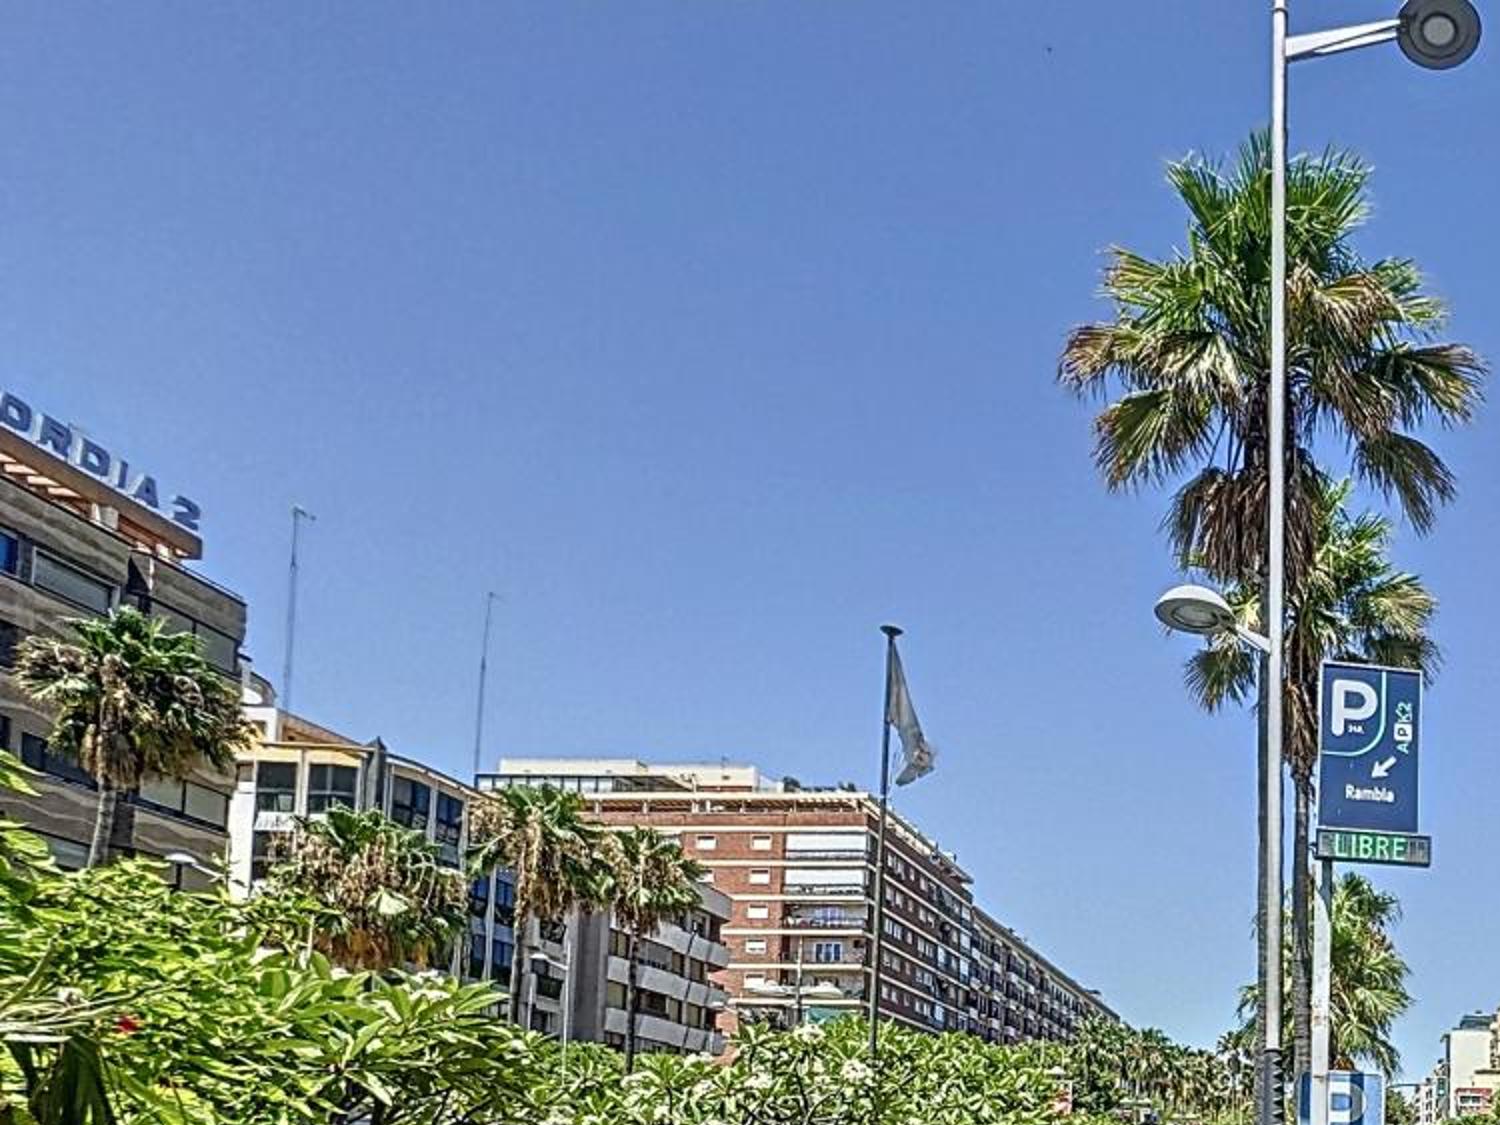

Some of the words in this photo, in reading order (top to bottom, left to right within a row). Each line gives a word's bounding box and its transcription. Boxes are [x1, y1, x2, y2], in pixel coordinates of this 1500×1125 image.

[1331, 679, 1378, 737] P
[1345, 784, 1395, 803] Rambla
[1335, 833, 1407, 860] LIBRE
